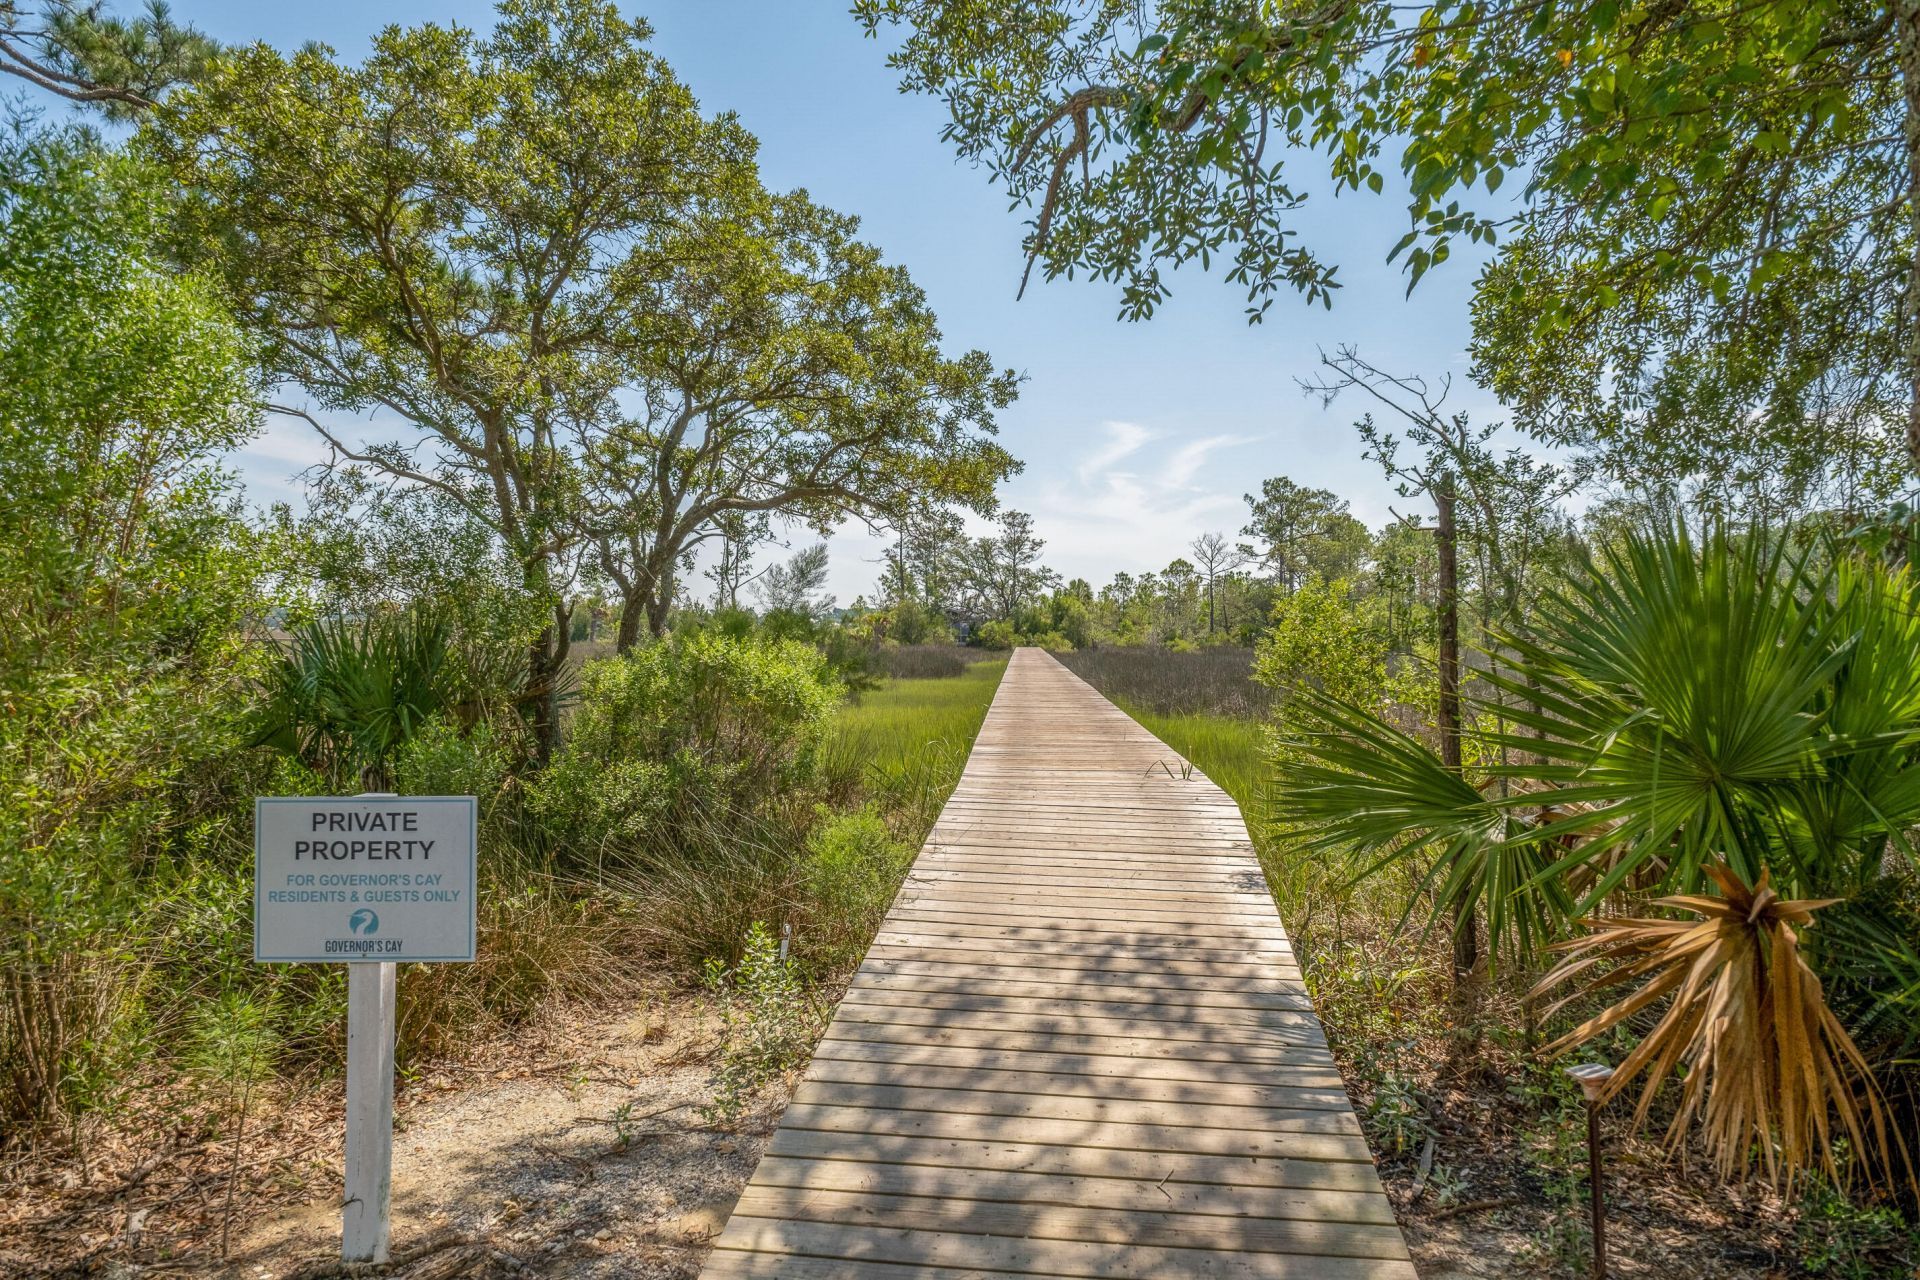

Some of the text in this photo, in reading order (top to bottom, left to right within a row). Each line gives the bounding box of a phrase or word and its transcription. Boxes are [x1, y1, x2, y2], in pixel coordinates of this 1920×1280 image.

[312, 812, 418, 832] PRIVATE
[295, 841, 435, 860] PROPERTY
[287, 874, 442, 886] FOR GOVERNOR'S CAY
[269, 890, 460, 902] RESIDENTS & GUESTS ONLY
[325, 940, 403, 953] GOVERNOR'S CAY
